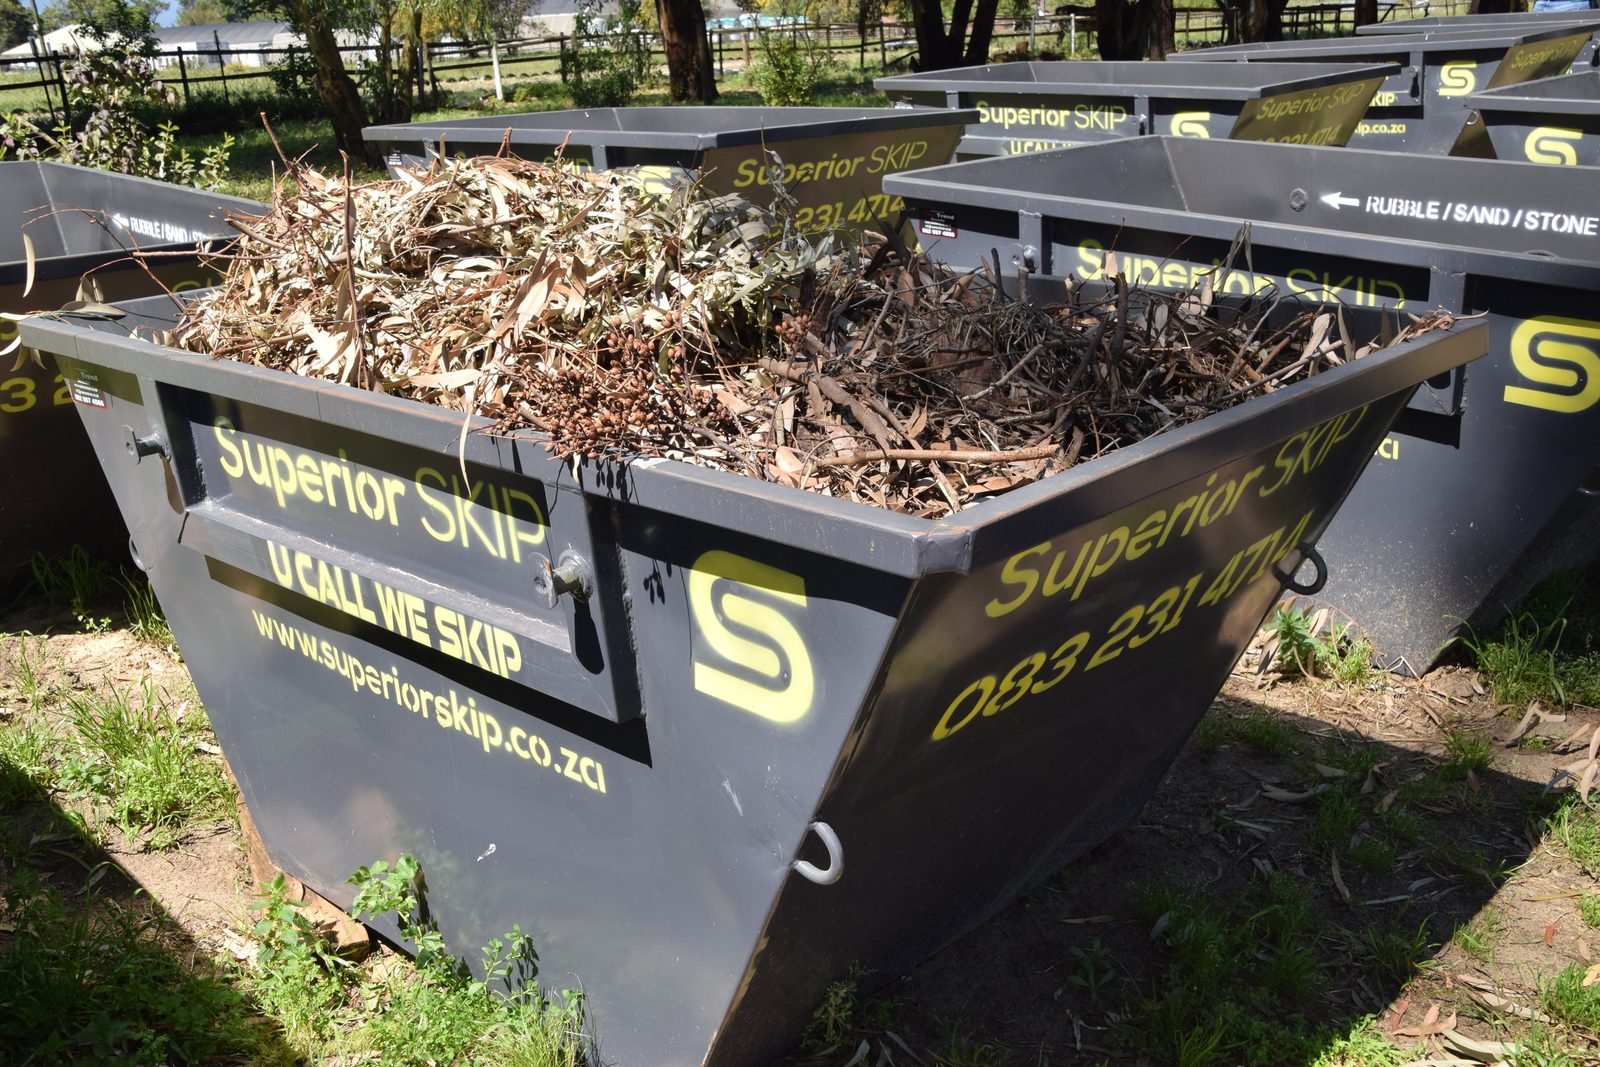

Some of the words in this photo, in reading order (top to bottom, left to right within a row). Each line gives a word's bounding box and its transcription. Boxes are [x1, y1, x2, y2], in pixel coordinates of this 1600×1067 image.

[976, 101, 1070, 130] Superior
[1074, 104, 1127, 130] SKIP
[1255, 92, 1329, 121] Superior
[1327, 83, 1365, 109] SKIP
[1369, 91, 1396, 107] KIP
[733, 153, 865, 187] Superior
[866, 141, 927, 174] SKIP
[1365, 195, 1440, 220] RUBBLE
[1453, 203, 1511, 226] SAND
[1524, 210, 1600, 236] STONE
[1286, 267, 1406, 310] SKIP
[213, 416, 405, 527] Superior
[415, 466, 546, 563] SKIP
[984, 464, 1264, 618] Superior
[1259, 404, 1370, 497] SKIP
[267, 540, 293, 588] U
[294, 549, 377, 625] CALL
[374, 580, 432, 648] WE
[434, 603, 522, 680] SKIP
[931, 631, 1091, 741] 083
[1083, 573, 1203, 672] 231
[1197, 510, 1314, 608] 4714
[252, 609, 608, 794] www.superiorskip.co.za
